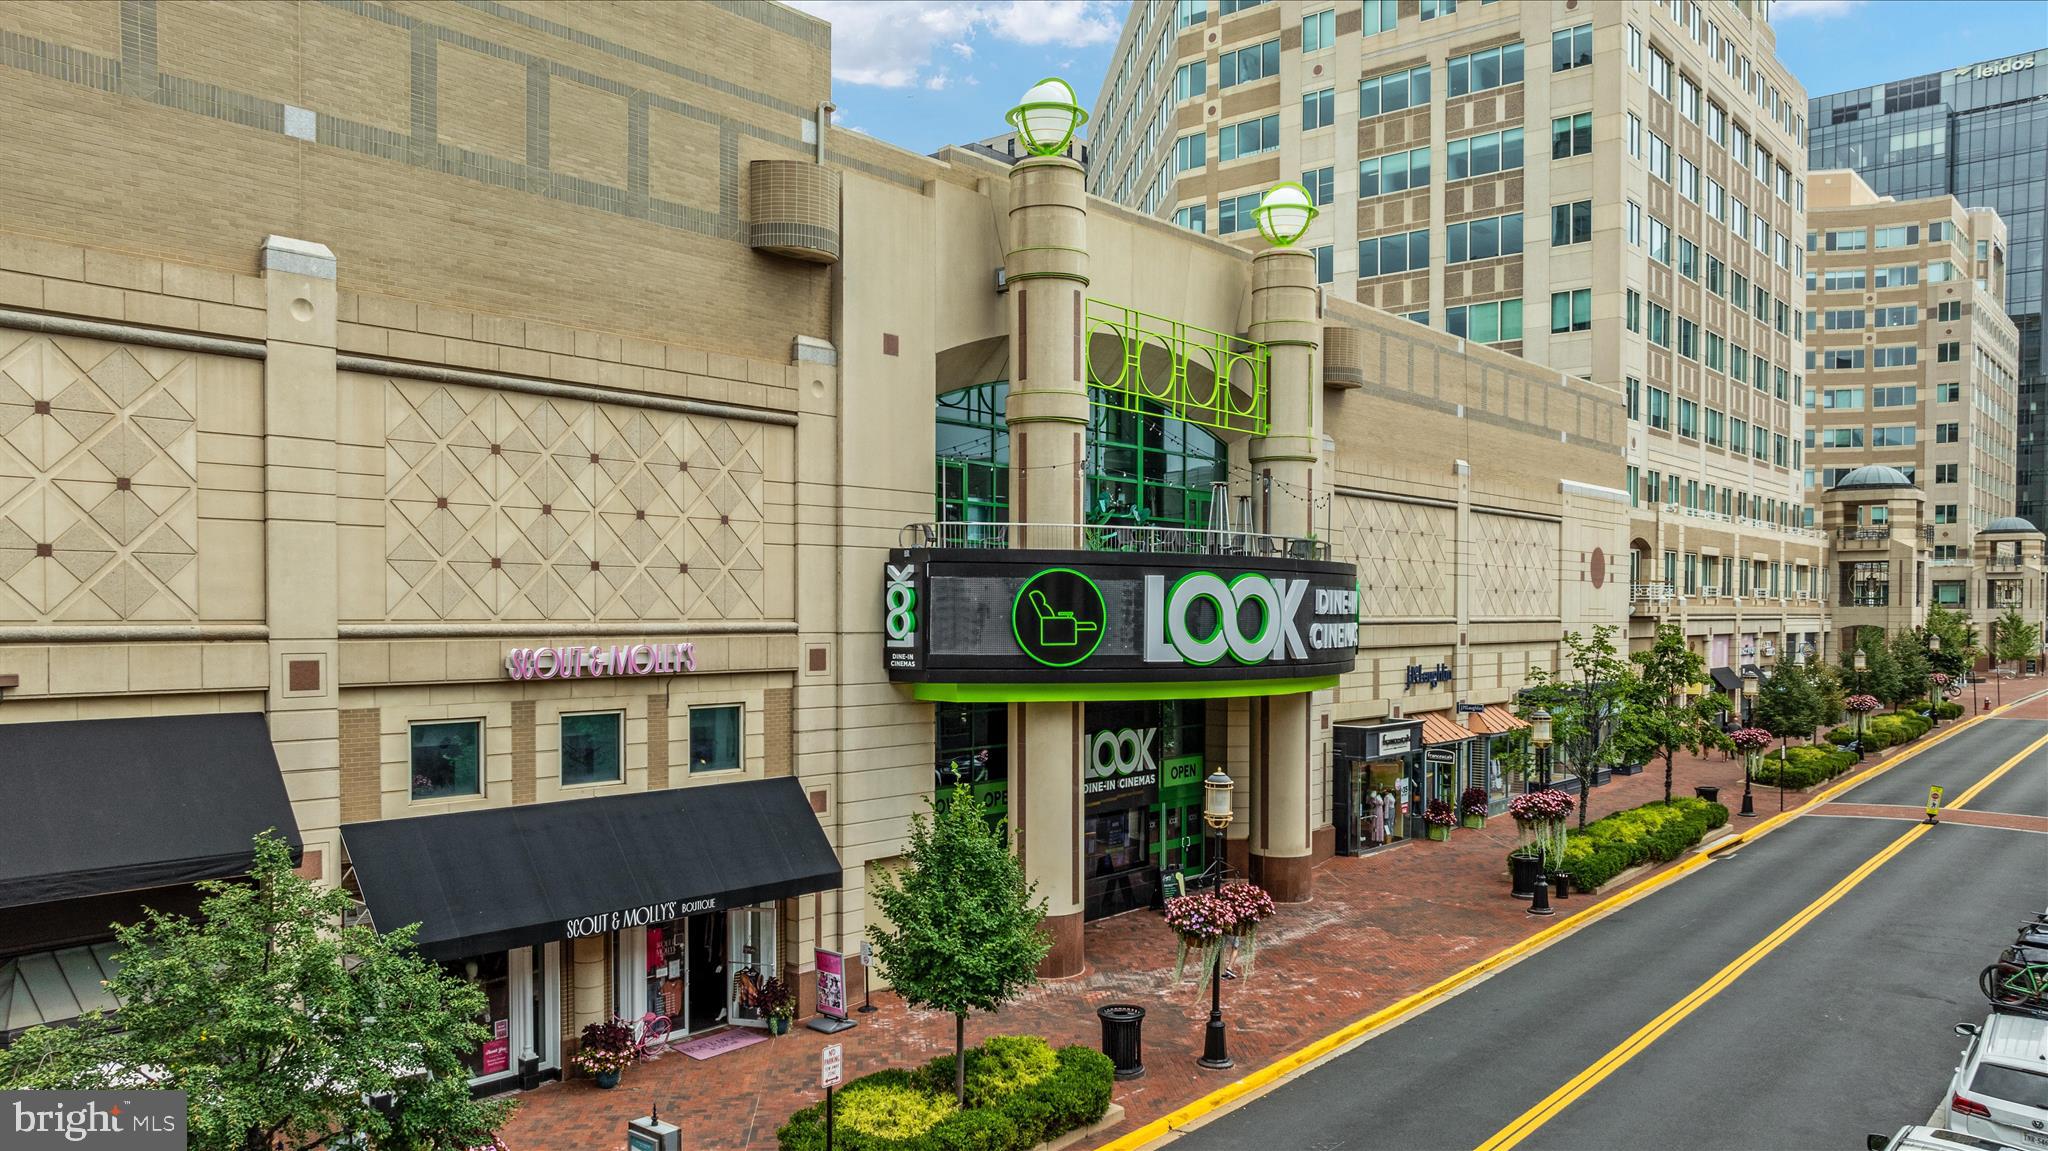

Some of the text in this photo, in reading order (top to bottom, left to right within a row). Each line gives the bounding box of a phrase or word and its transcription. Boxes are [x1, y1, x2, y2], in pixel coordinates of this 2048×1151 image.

[1977, 57, 2035, 79] leidos
[887, 564, 916, 648] LOOK
[1144, 571, 1309, 666] LOOK
[510, 642, 697, 680] SCOUT & MOLLY'S
[1084, 728, 1158, 778] LOOK
[1171, 764, 1196, 779] OPEN
[984, 790, 1008, 808] OPE
[1084, 774, 1156, 794] DINE-IN CINEMAS
[567, 913, 609, 938] SCOUT
[612, 911, 620, 930] &
[681, 898, 716, 913] BOUTIQUE
